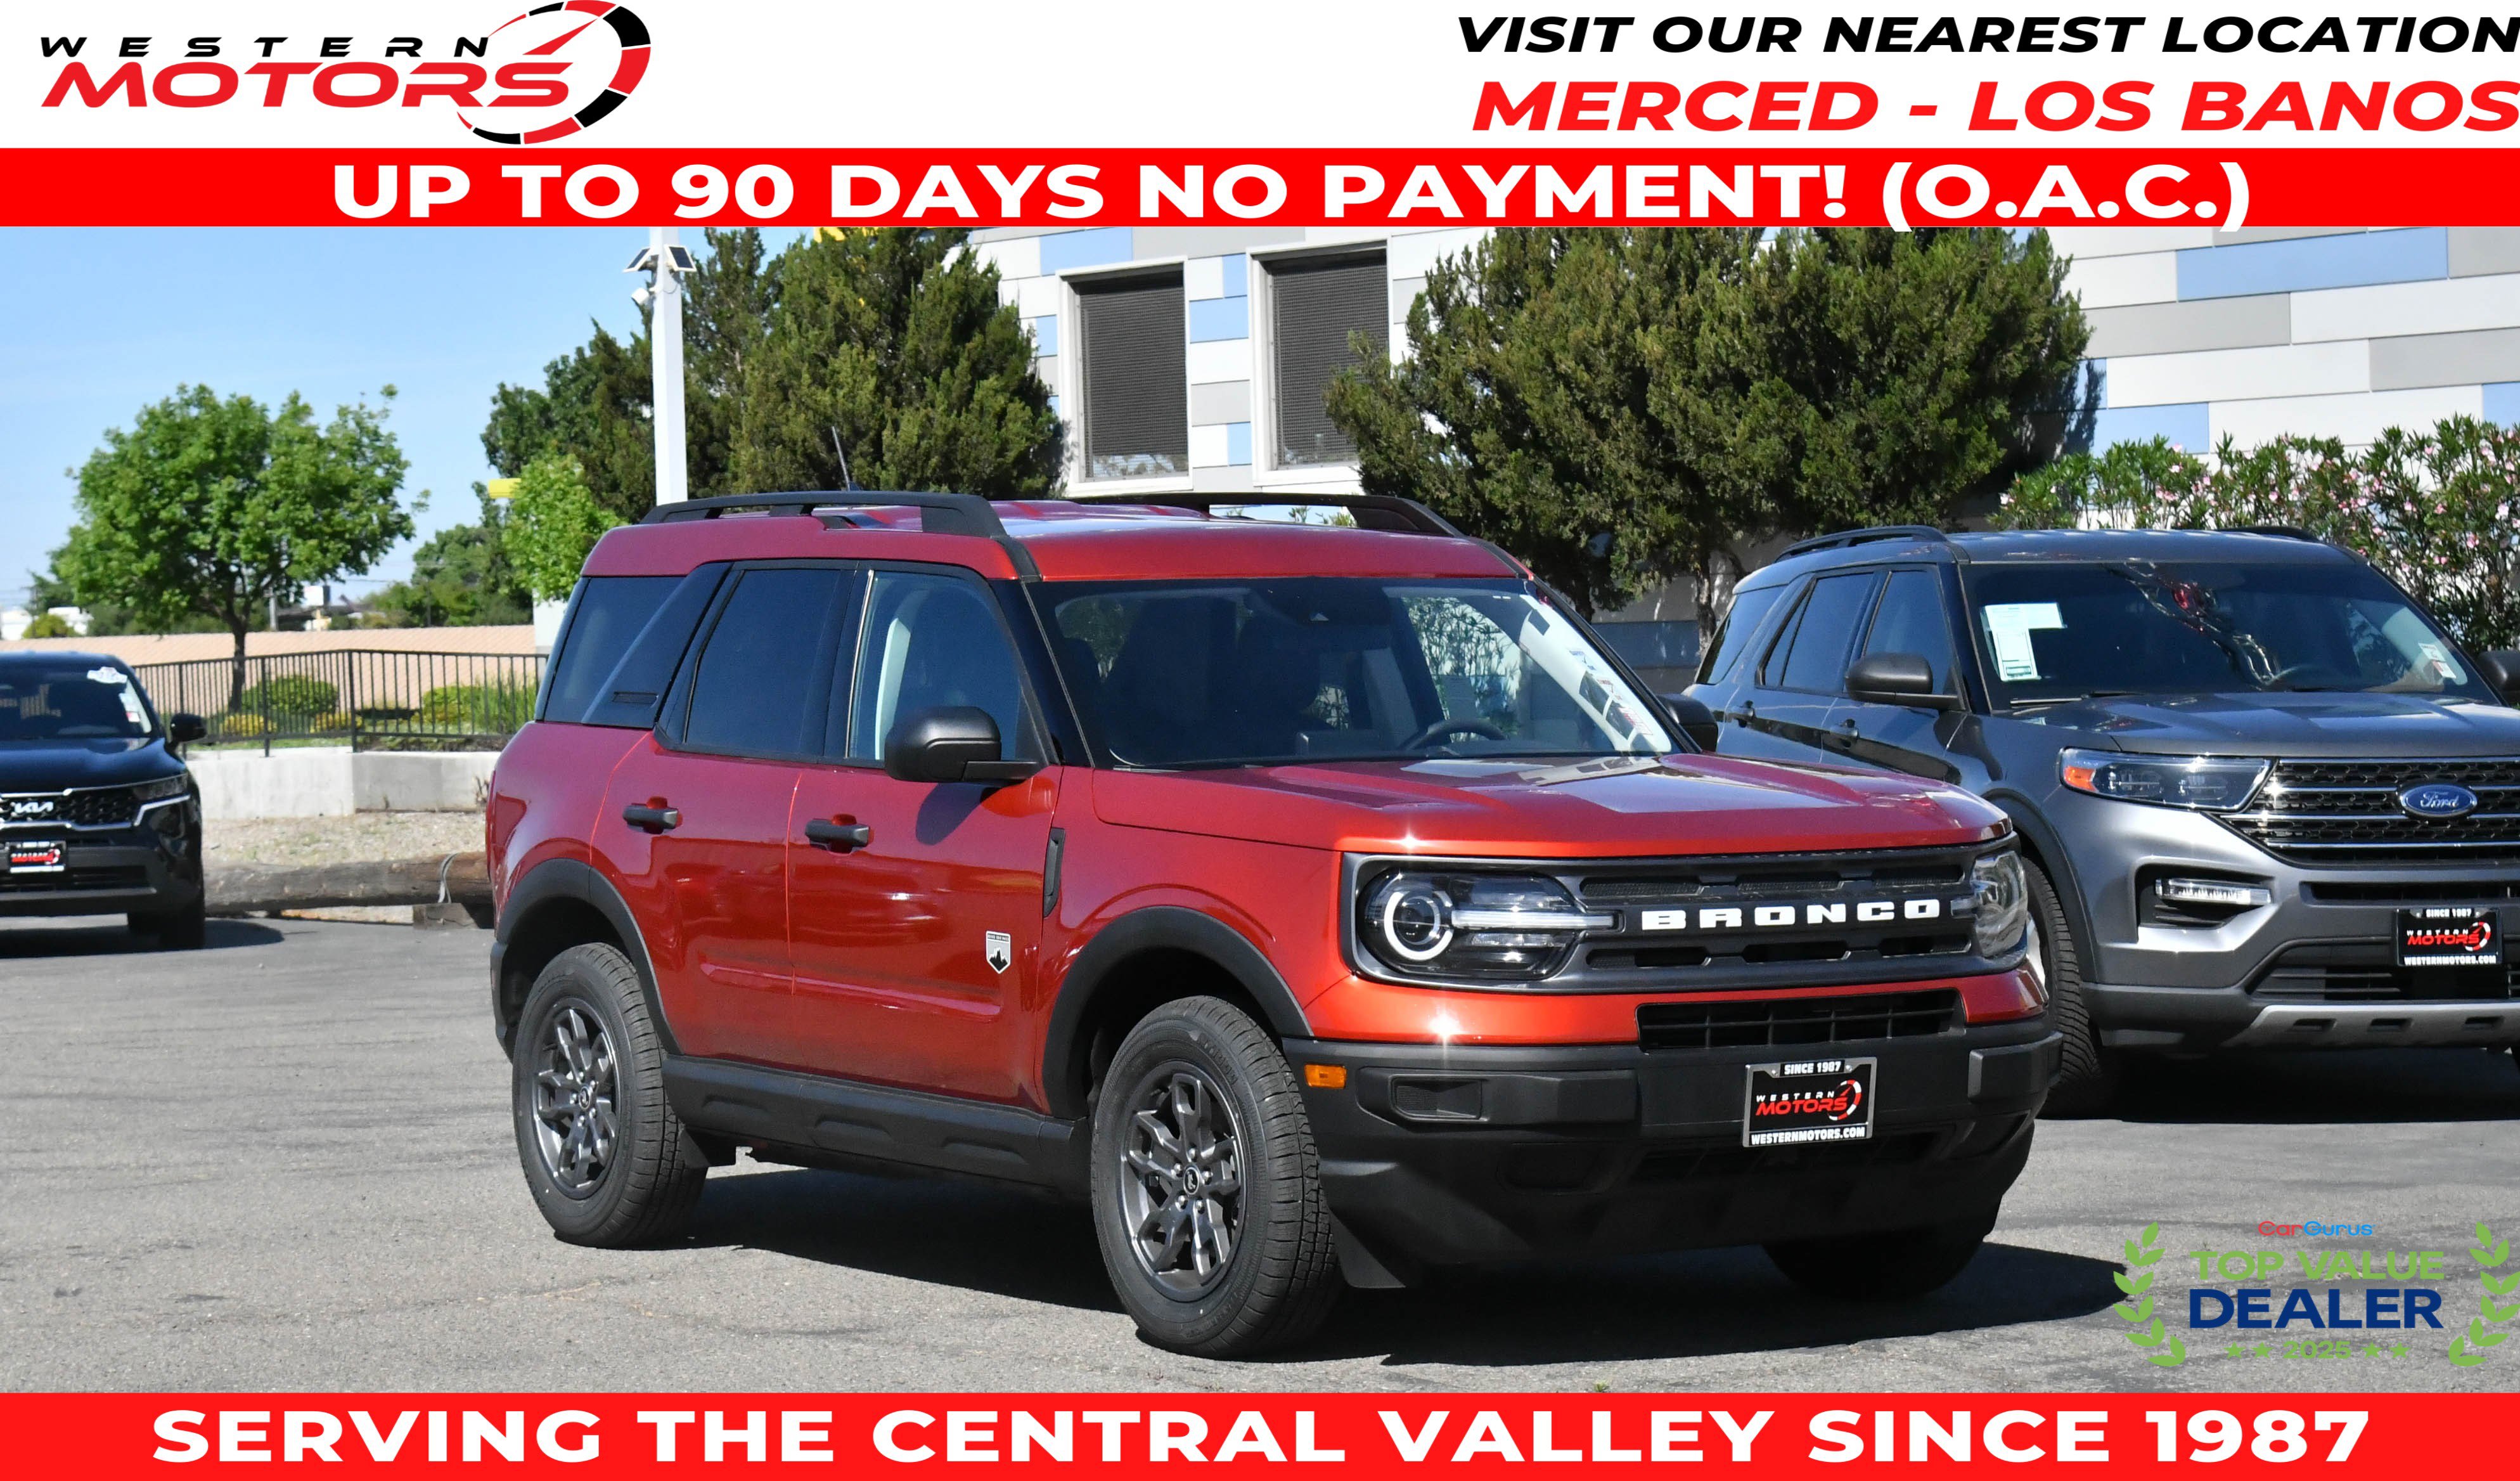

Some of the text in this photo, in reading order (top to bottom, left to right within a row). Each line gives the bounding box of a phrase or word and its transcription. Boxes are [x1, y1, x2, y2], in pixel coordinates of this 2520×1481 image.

[2420, 791, 2460, 808] Ford
[1642, 899, 1940, 930] BRONCO
[2407, 934, 2479, 945] MOTORS
[2404, 955, 2497, 966] WESTERNMOTORS.COM
[1784, 1061, 1841, 1075] SINCE 1987
[1756, 1090, 1834, 1102] WESTERN
[1756, 1097, 1848, 1116] MOTORS
[1751, 1127, 1865, 1145] WESTERNMOTORS.COM
